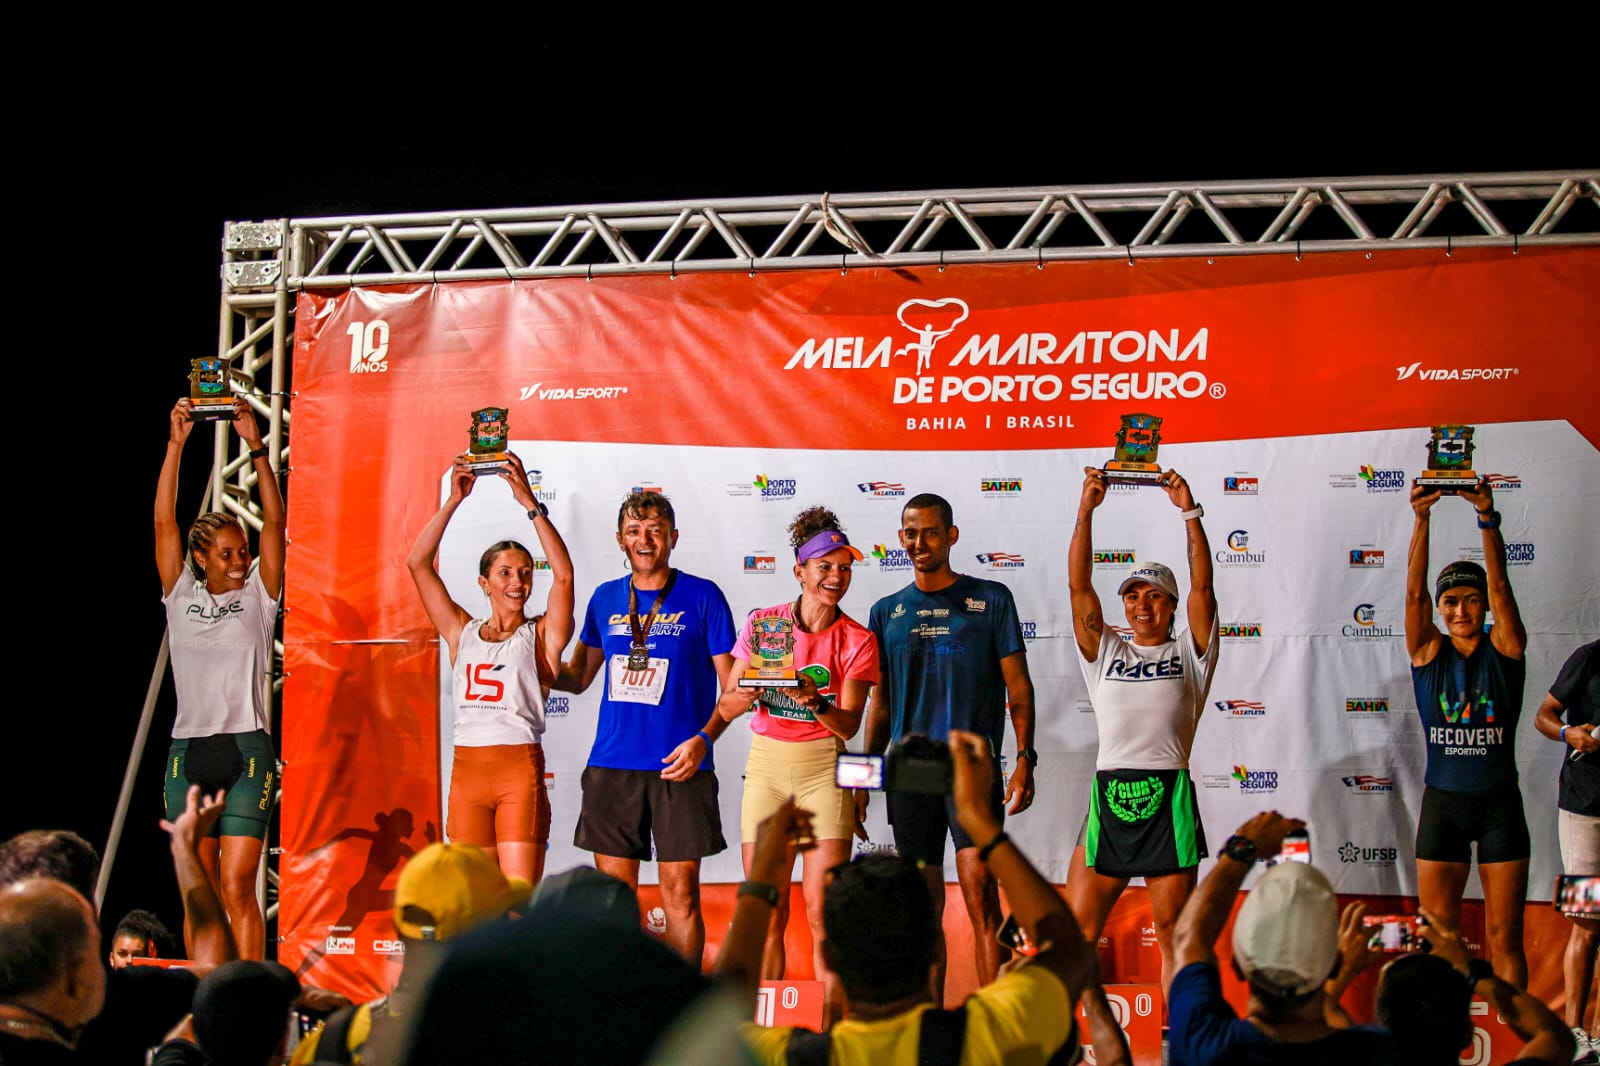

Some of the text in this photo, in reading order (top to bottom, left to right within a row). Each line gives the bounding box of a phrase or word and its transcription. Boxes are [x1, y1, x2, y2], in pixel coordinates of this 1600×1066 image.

[346, 320, 389, 373] 10
[784, 328, 1208, 370] MEIA MARATONA
[352, 361, 388, 373] ANOS
[893, 376, 935, 404] DE
[940, 375, 1063, 403] PORTO
[906, 417, 966, 430] BAHIA
[1006, 415, 1075, 429] BRASIL
[1373, 471, 1404, 480] PORTO
[767, 479, 796, 488] PORTO
[981, 481, 1022, 491] BAHIA
[1366, 479, 1404, 488] SEGURO
[761, 488, 796, 496] SEGURO
[886, 550, 908, 558] PORT
[1094, 553, 1136, 563] BAHIA
[1216, 550, 1265, 563] Cambuí
[1507, 553, 1534, 561] GURO
[624, 624, 686, 636] SORT
[1220, 627, 1263, 637] BAHIA
[1342, 624, 1392, 637] Cambuí
[1105, 656, 1184, 680] RACES
[621, 665, 657, 687] 7077
[546, 697, 569, 705] ORTO
[1346, 701, 1389, 711] BAHIA
[782, 709, 807, 719] TEAM
[1430, 726, 1504, 746] RECOVERY
[1445, 747, 1487, 756] ESPORTIVO
[1247, 771, 1278, 780] PORTO
[1117, 780, 1151, 799] CLUB
[1240, 780, 1278, 789] SEGURO
[1363, 848, 1397, 860] UFSB
